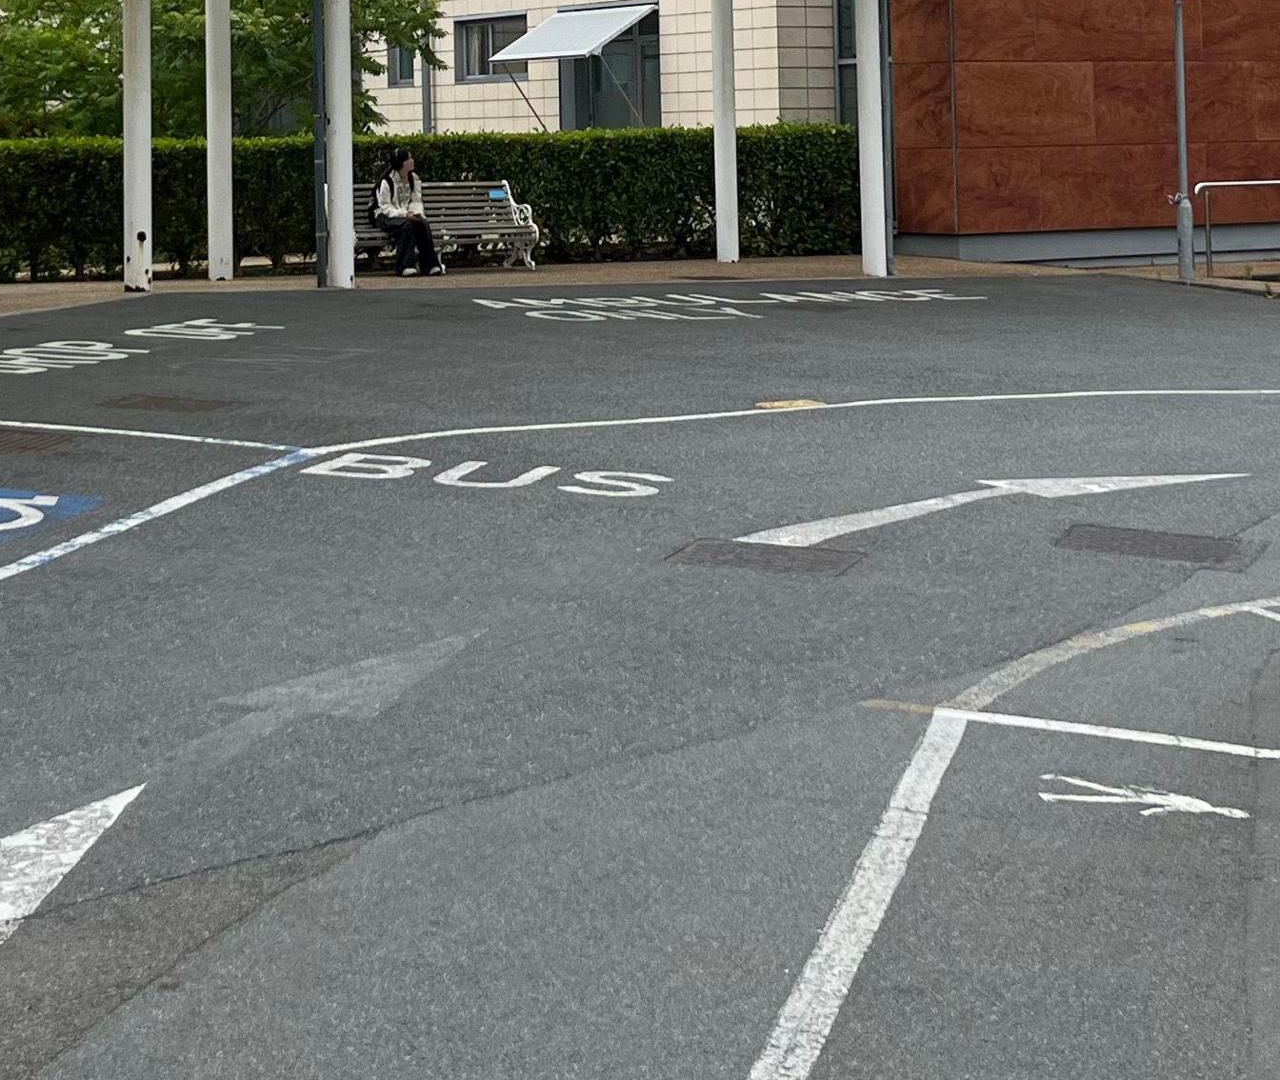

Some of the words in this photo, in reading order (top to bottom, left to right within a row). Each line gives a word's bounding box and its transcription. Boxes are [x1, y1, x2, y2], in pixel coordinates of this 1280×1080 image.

[471, 289, 988, 309] AMBULANCE
[524, 307, 764, 322] ONLY
[124, 318, 286, 340] OFF
[300, 452, 674, 497] BUS
